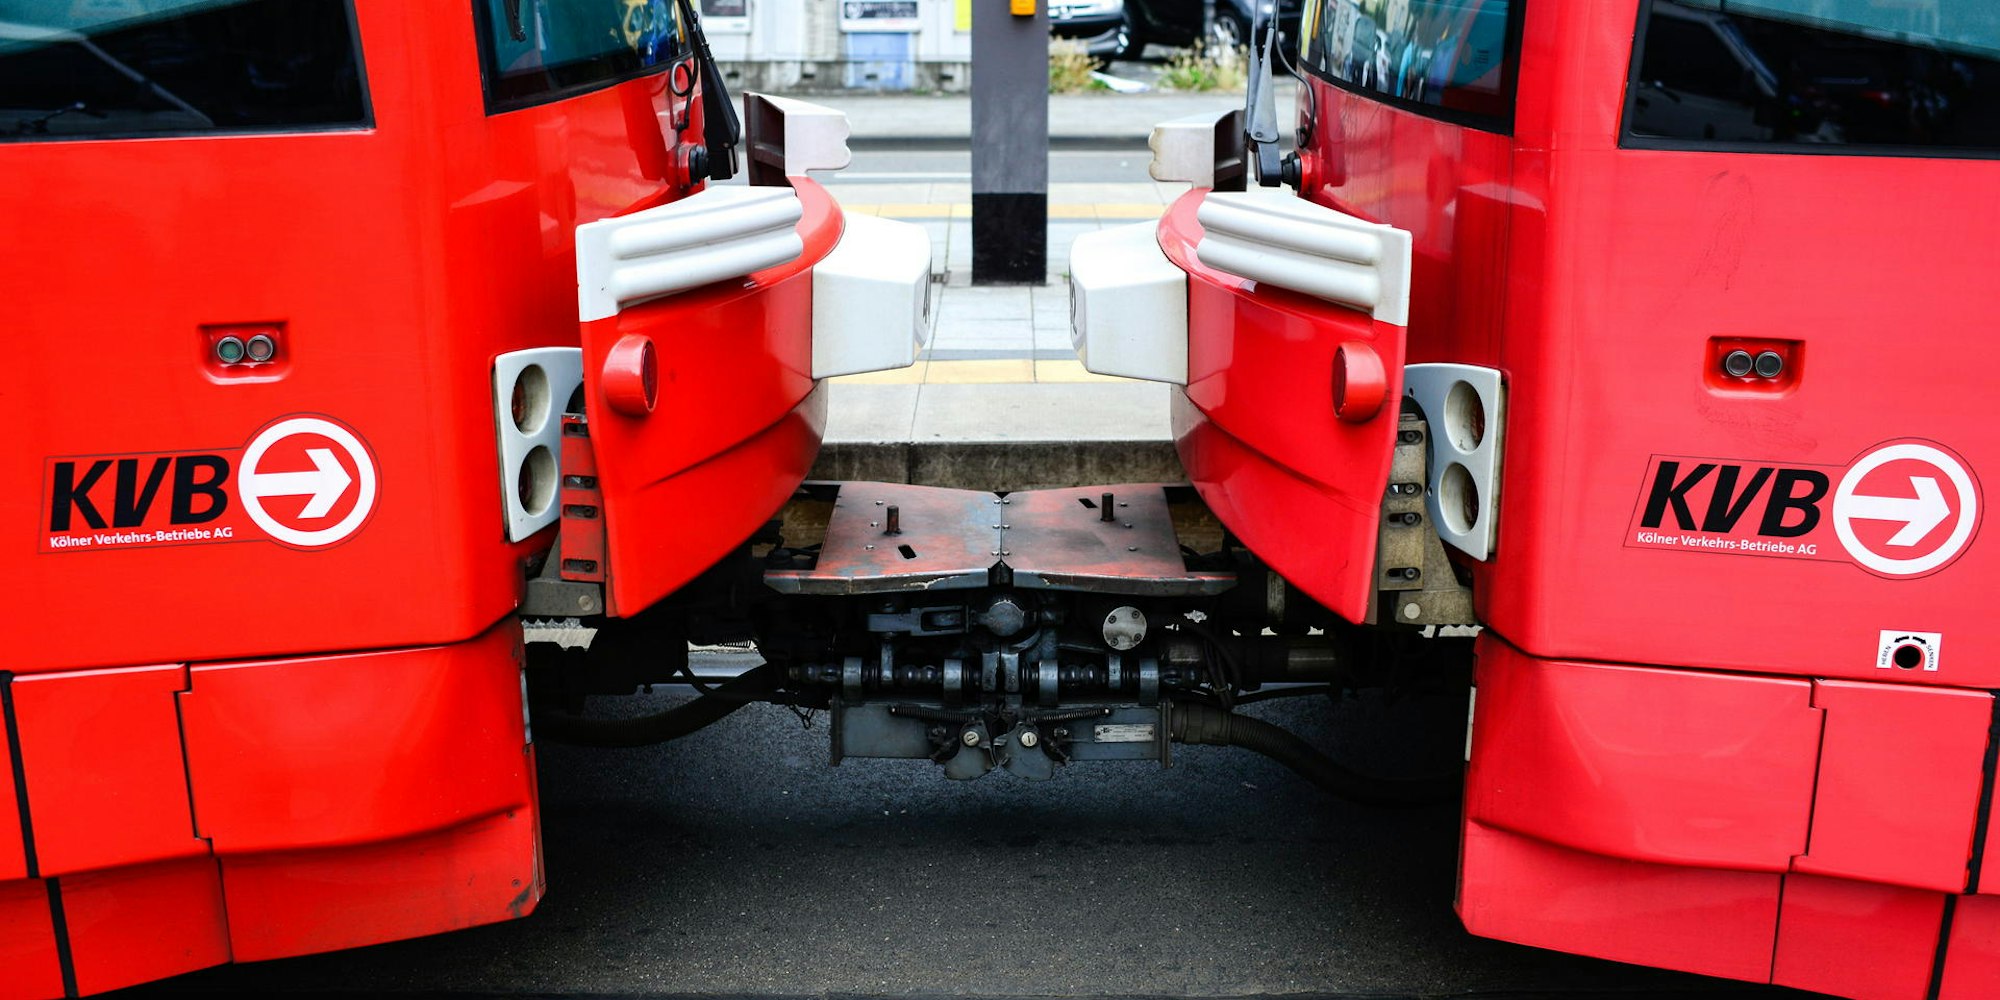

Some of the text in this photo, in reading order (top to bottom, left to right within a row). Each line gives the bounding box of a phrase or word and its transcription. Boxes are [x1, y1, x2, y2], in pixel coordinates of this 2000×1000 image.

[50, 455, 230, 532] KVB
[1640, 461, 1829, 537] KVB
[50, 527, 233, 548] Kölner Verkehrs-Betriebe AG
[1637, 532, 1817, 555] Kölner Verkehrs-Betriebe AG
